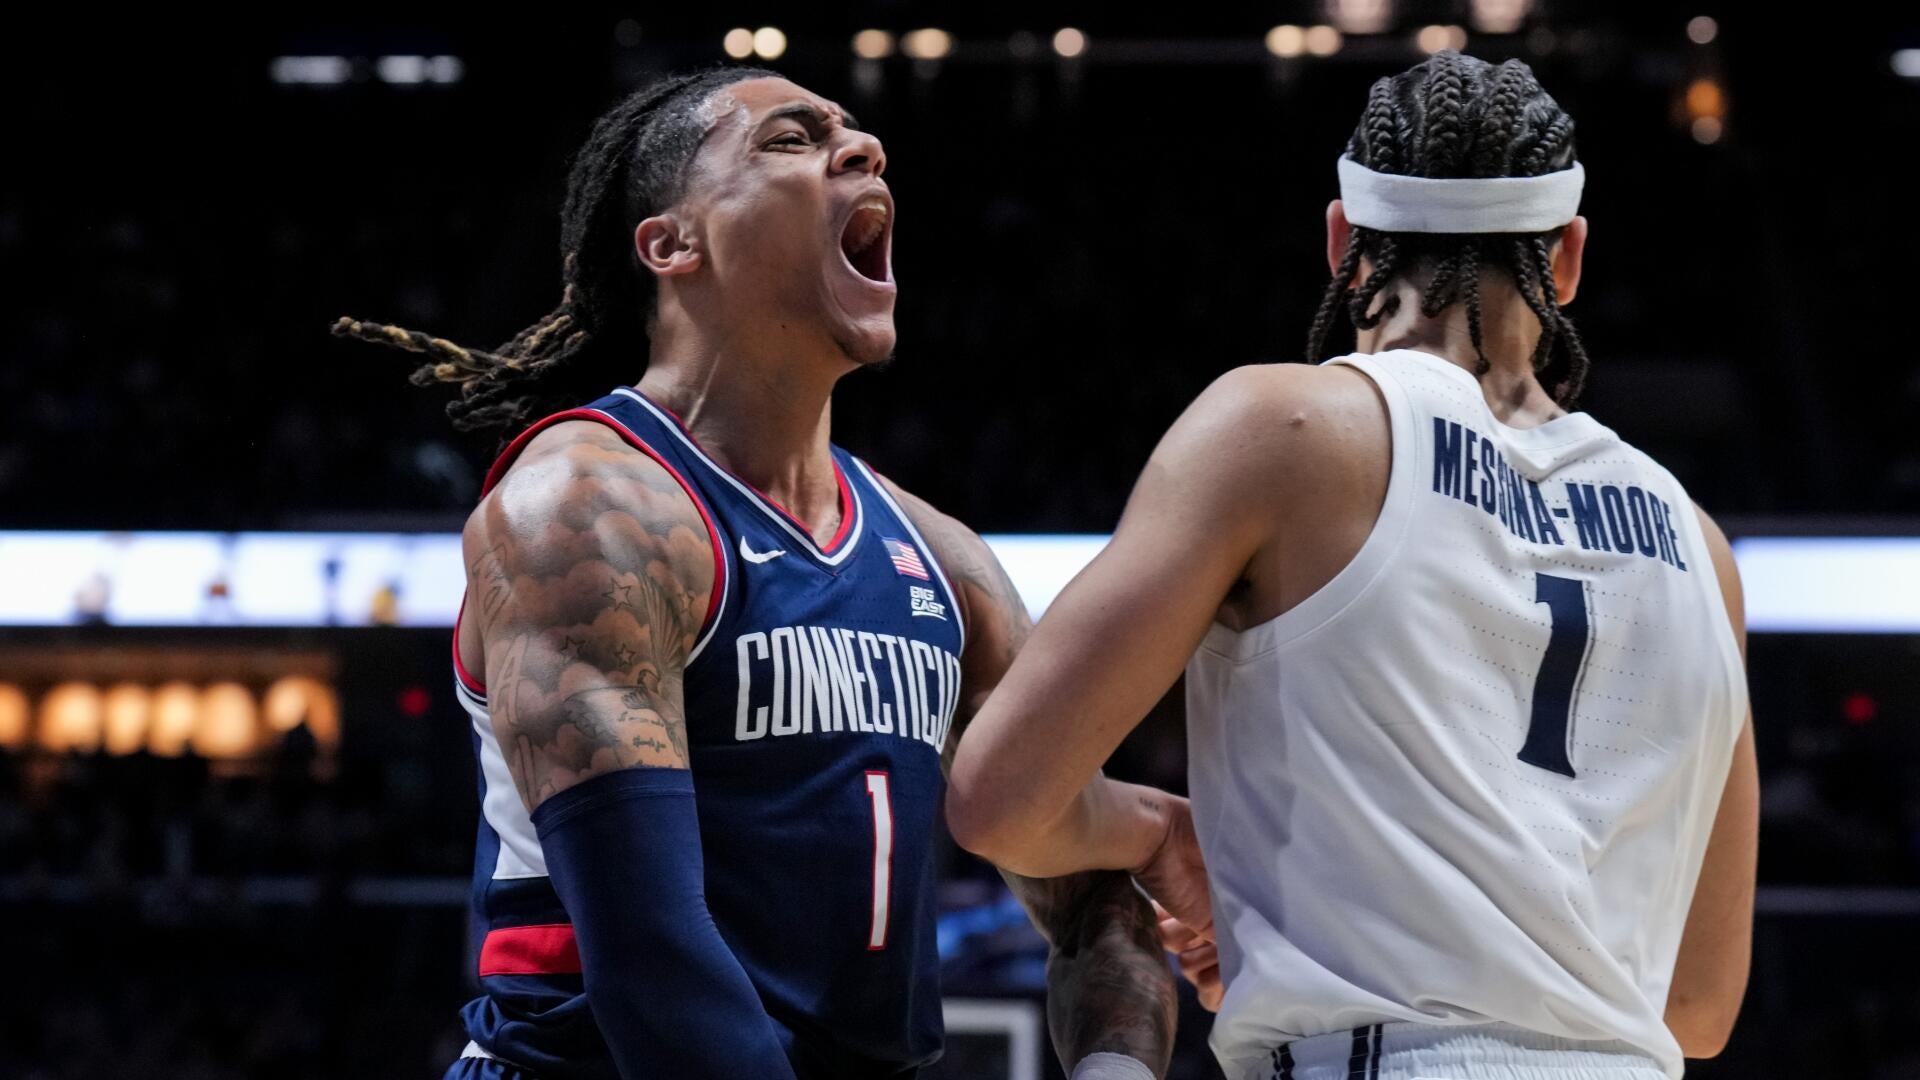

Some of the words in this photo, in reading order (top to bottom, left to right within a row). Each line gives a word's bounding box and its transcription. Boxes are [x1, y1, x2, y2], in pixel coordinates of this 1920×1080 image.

[910, 586, 934, 601] BIG
[911, 598, 945, 615] EAST
[1517, 572, 1596, 778] 1
[865, 770, 893, 950] 1
